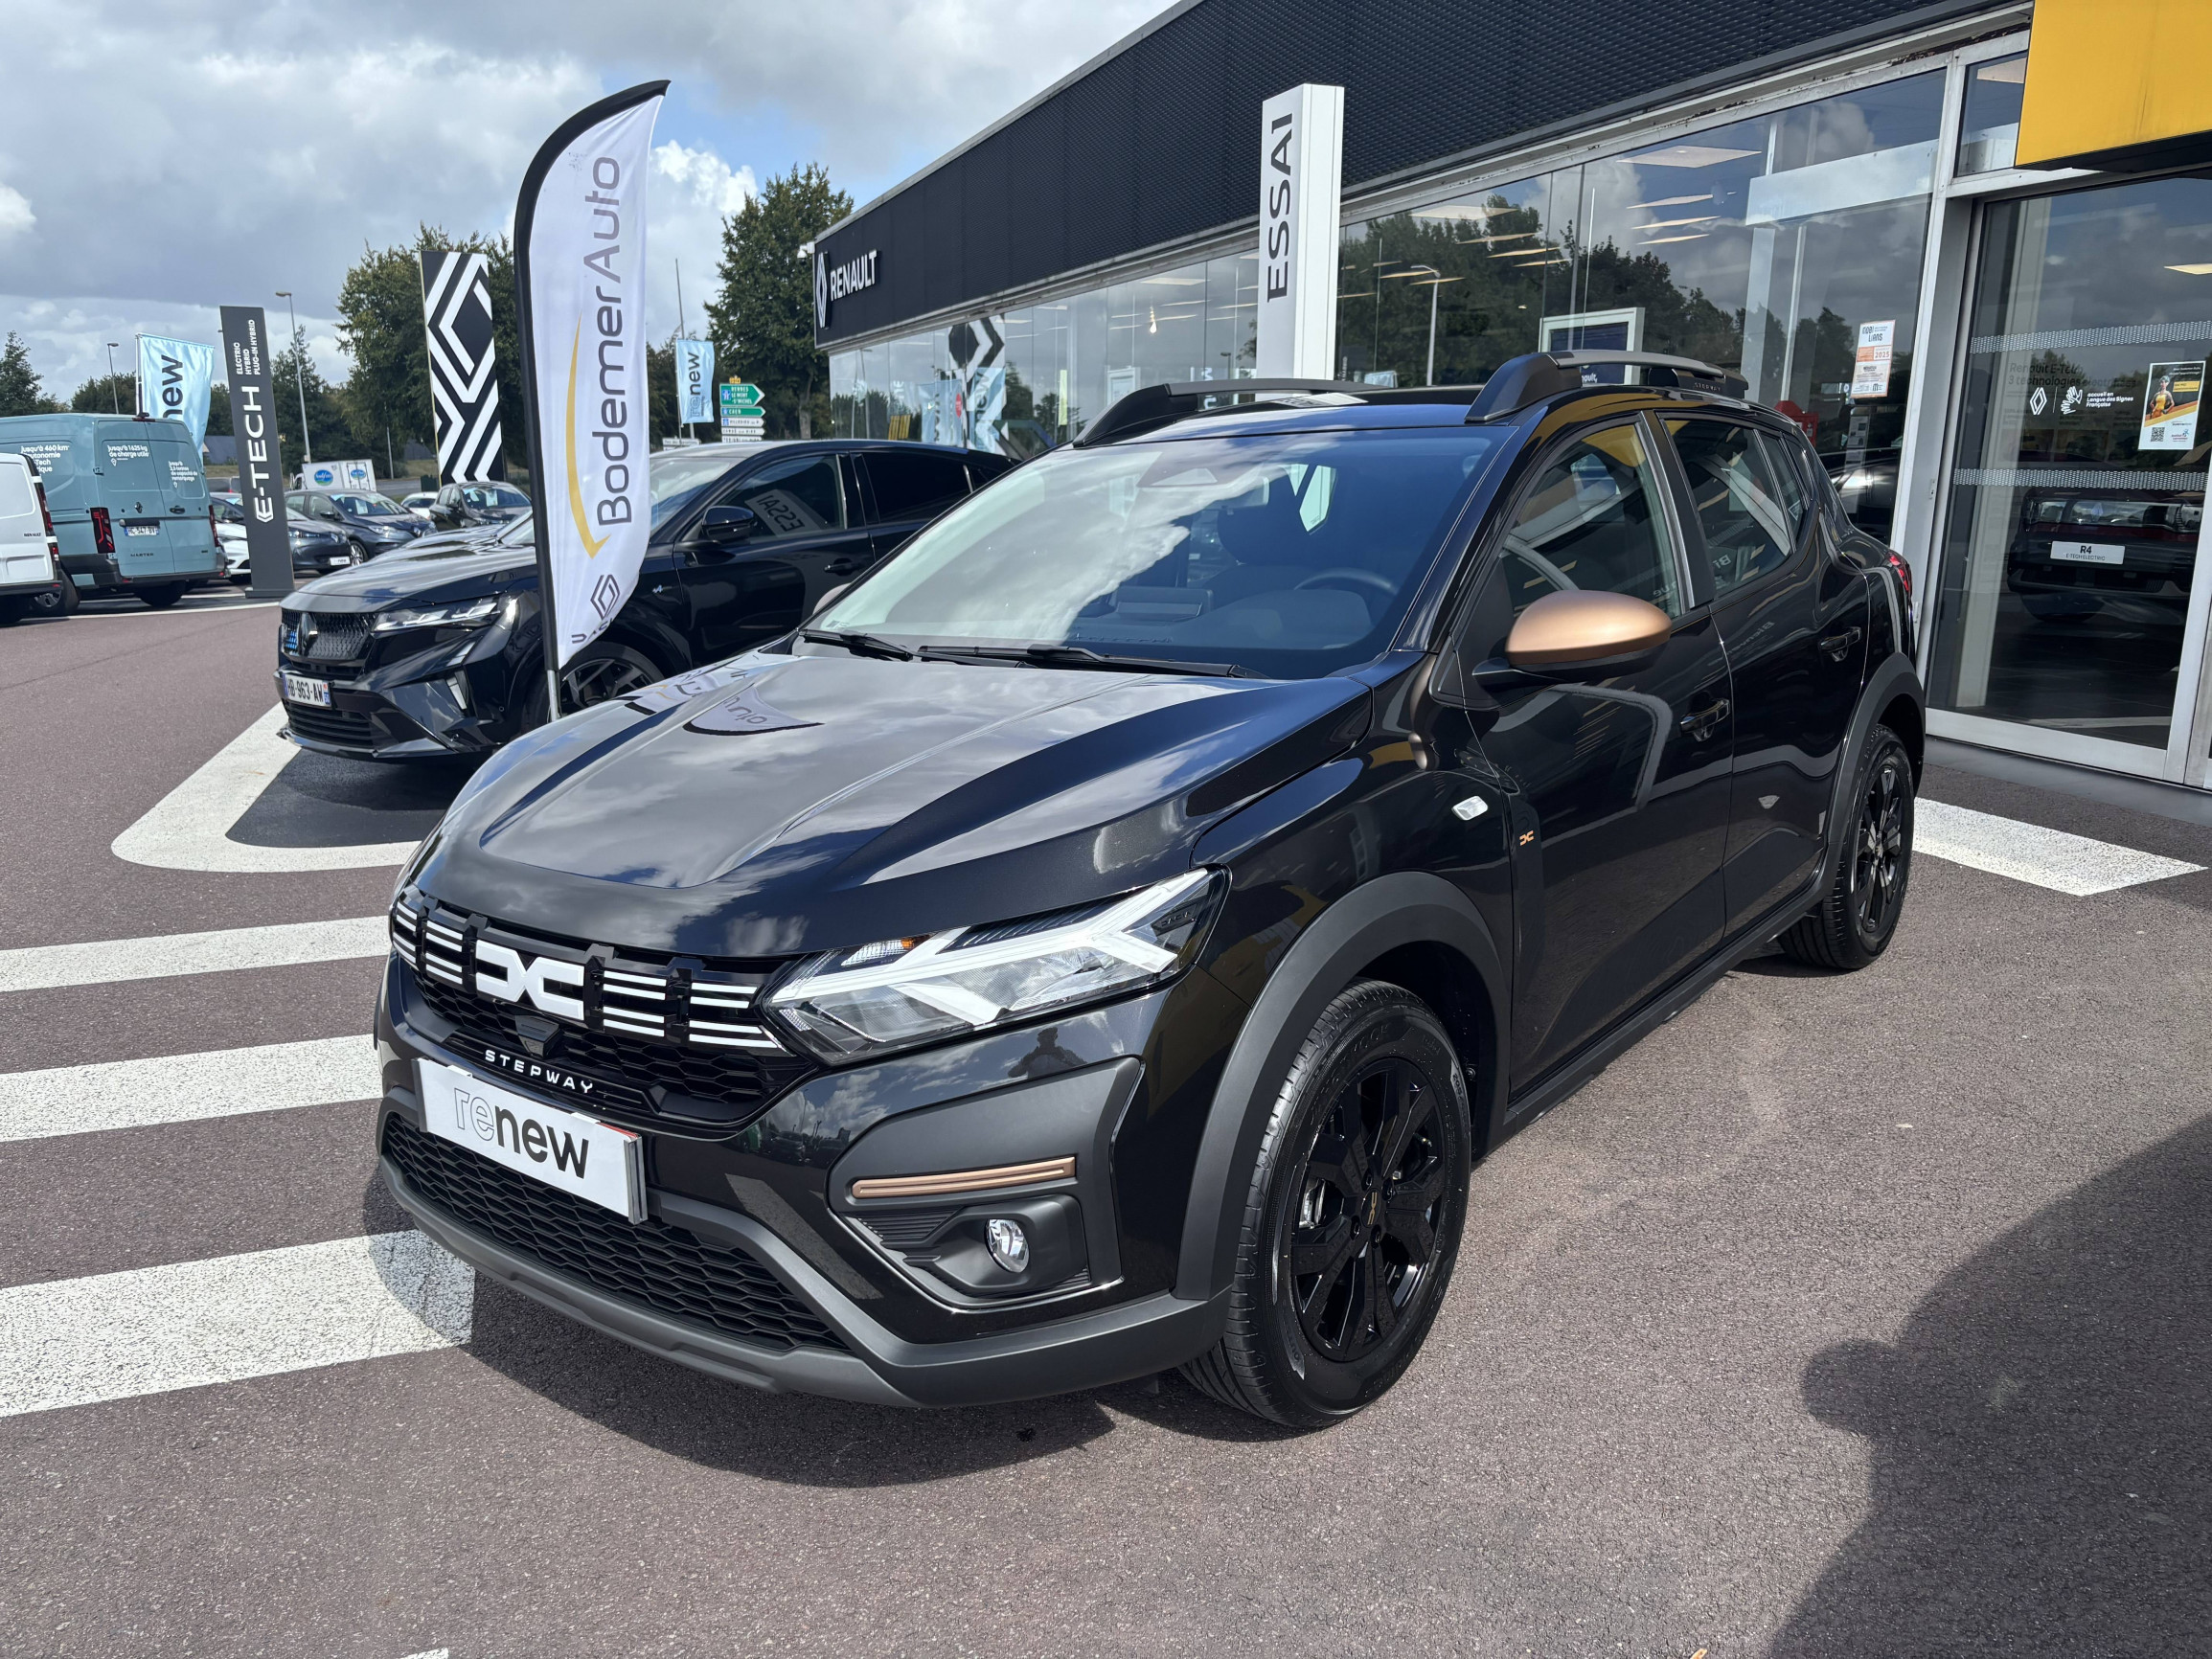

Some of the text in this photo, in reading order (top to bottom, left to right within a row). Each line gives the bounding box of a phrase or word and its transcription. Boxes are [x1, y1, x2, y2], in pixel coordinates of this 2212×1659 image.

[1267, 113, 1293, 303] ESSAI
[830, 250, 878, 302] RENAULT
[233, 342, 243, 375] ELECTRIC
[242, 349, 252, 375] HYBRID
[248, 319, 261, 375] PLUG-IN HYBRID
[161, 354, 183, 419] new
[241, 386, 274, 523] E-TECH
[2080, 545, 2092, 554] R4
[485, 1049, 593, 1094] STEPWAY
[453, 1087, 590, 1179] renew
